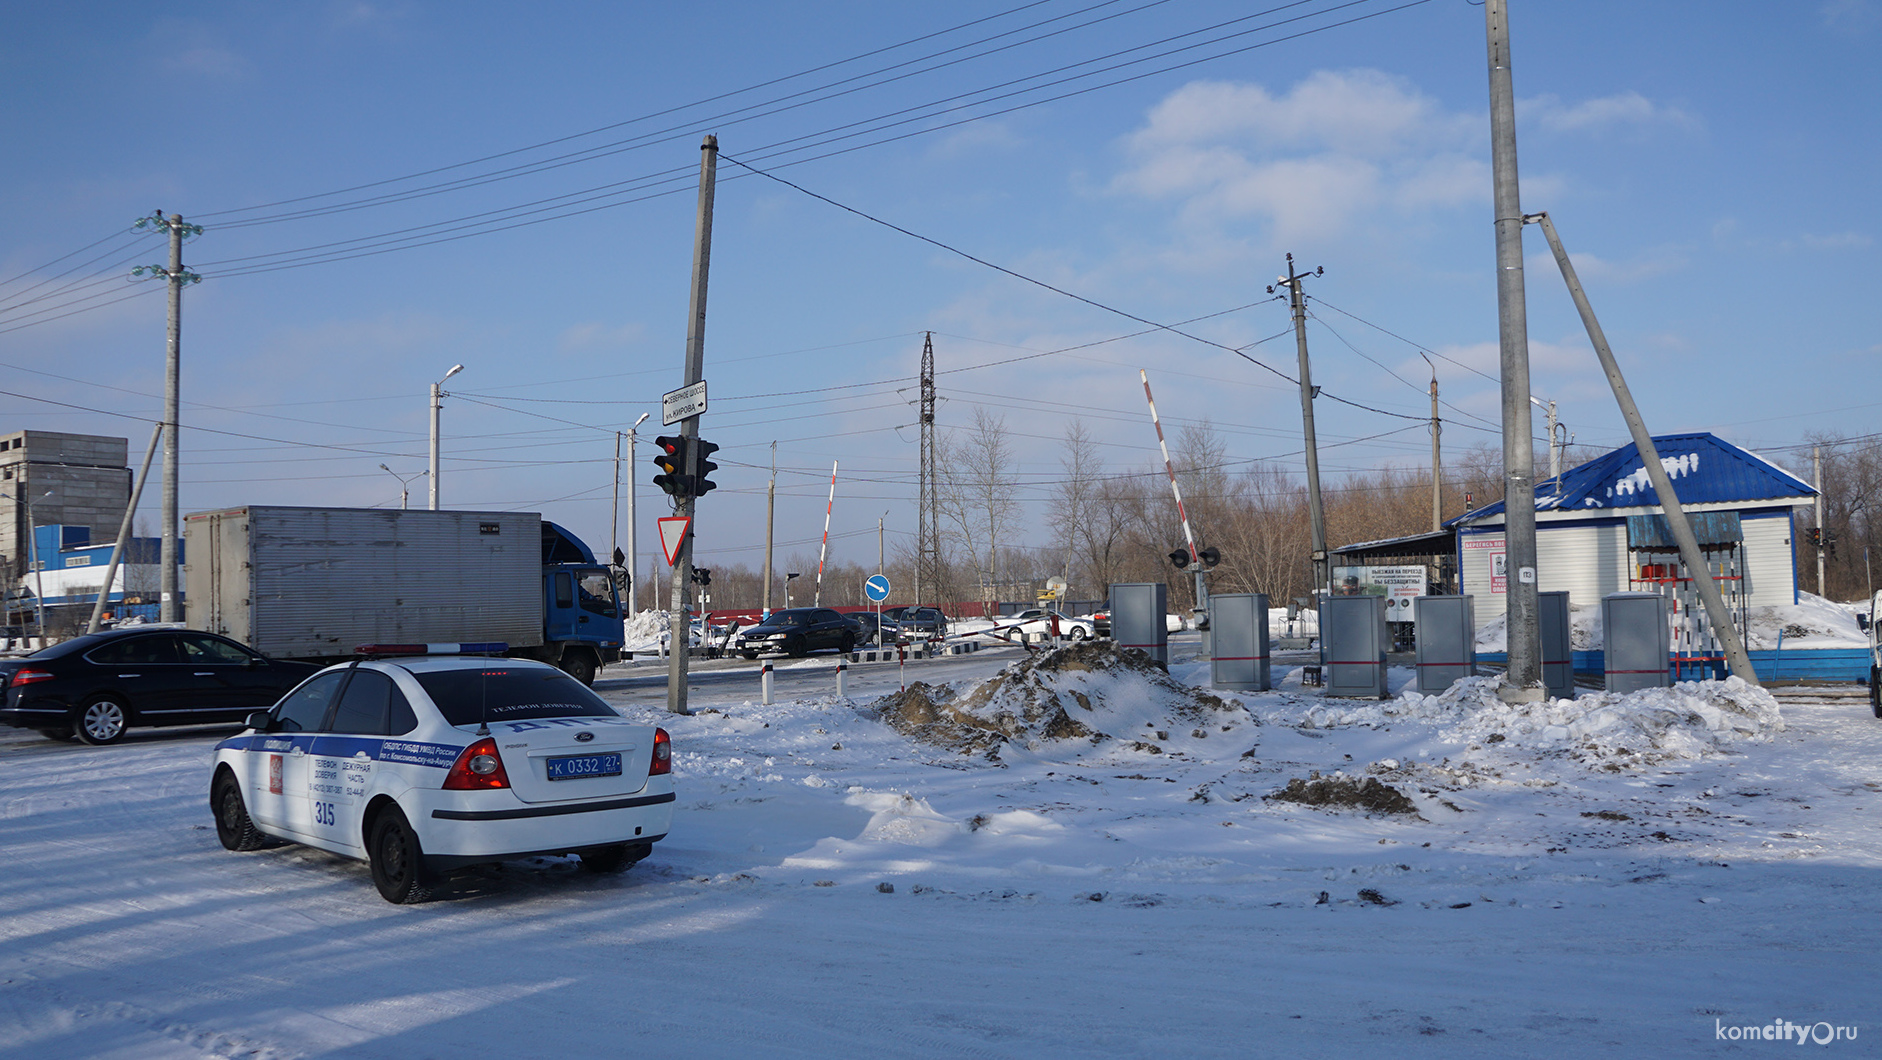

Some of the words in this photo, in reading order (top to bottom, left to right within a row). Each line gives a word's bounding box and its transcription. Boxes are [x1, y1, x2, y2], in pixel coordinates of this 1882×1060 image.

[667, 391, 689, 404] СЕВЕРНОЕ
[690, 385, 704, 397] ШОССЕ
[673, 404, 696, 418] КИРОВА
[1465, 541, 1493, 549] БЕРЕГИСЬ
[490, 702, 540, 713] ТЕЛЕФОН
[505, 718, 630, 732] ДПС
[383, 741, 401, 751] ОБДПС
[401, 742, 420, 753] ГИБДД
[419, 745, 436, 755] УМВД
[435, 747, 457, 757] России
[315, 759, 337, 769] ТЕЛЕФОН
[342, 761, 371, 773] ДЕЖУРНАЯ
[567, 758, 599, 774] 0332
[605, 756, 617, 767] 27
[315, 770, 337, 780] ДОВЕРИЯ
[347, 773, 365, 784] ЧАСТЬ
[315, 801, 335, 826] 315
